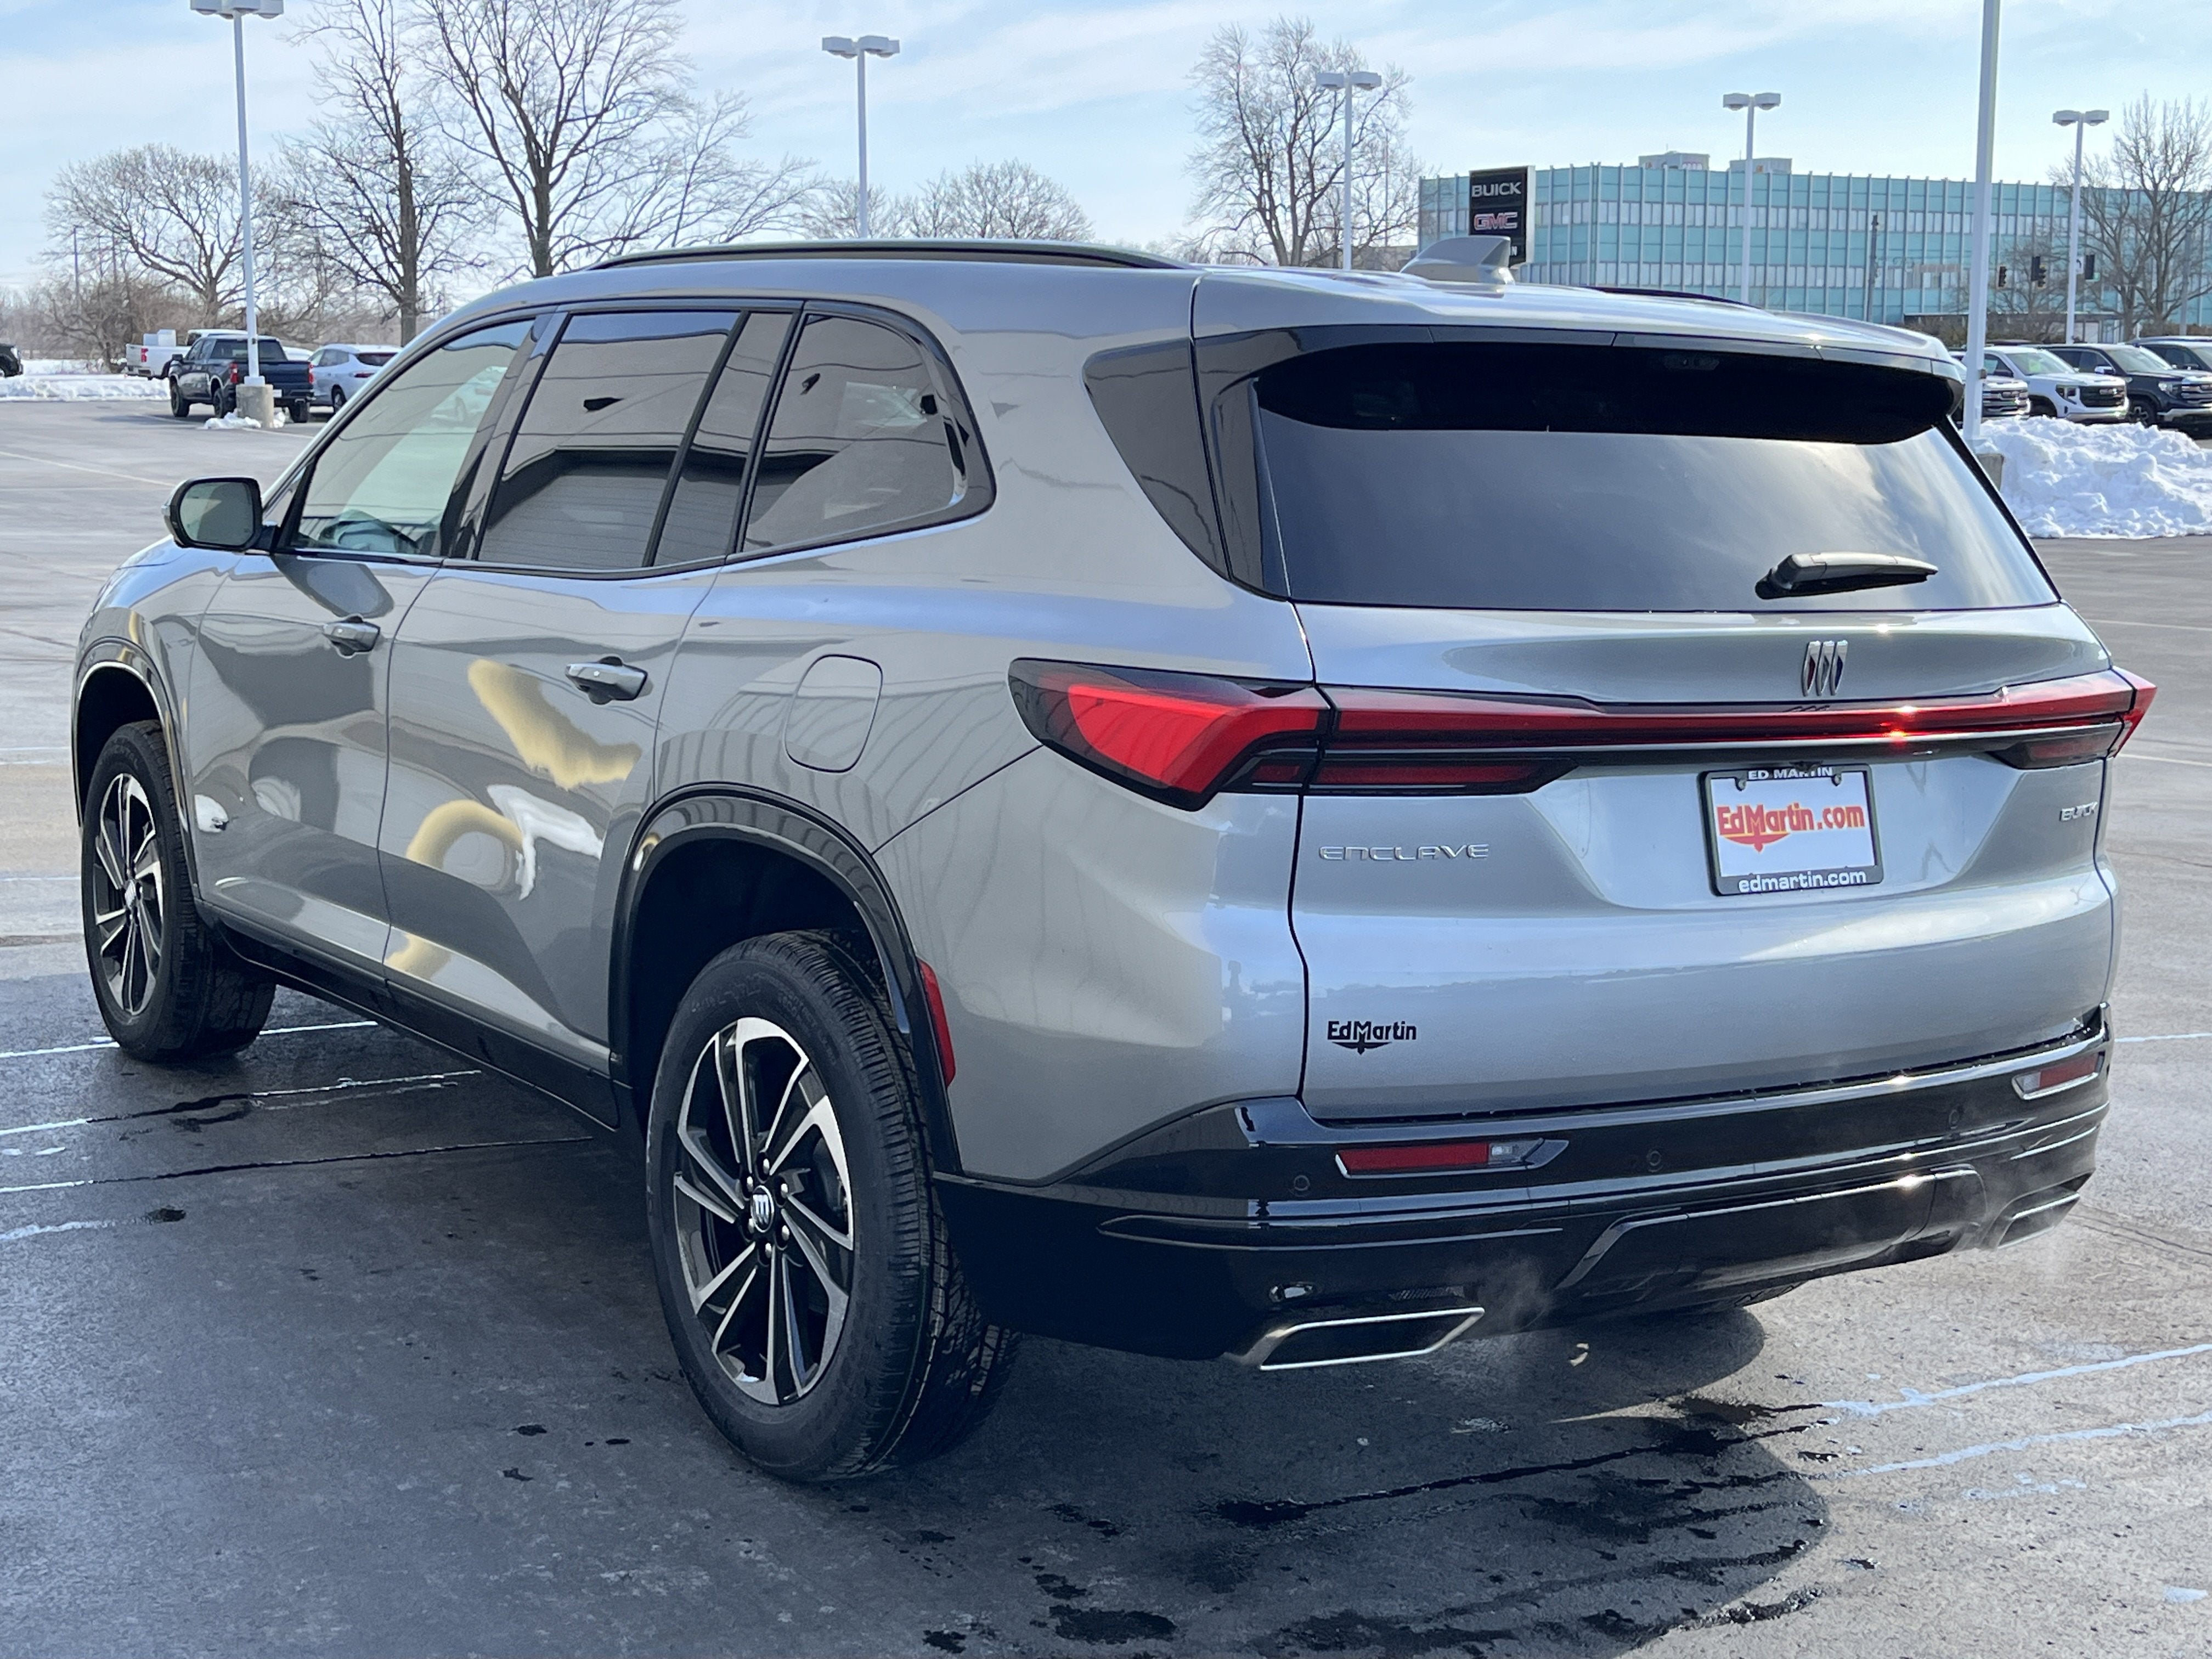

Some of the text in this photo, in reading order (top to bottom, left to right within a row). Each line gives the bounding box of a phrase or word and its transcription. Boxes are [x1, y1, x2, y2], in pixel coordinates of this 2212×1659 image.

[1471, 182, 1522, 198] BUICK
[1474, 212, 1518, 230] GMC
[1748, 770, 1769, 780] ED
[1716, 802, 1865, 836] EdMartin.com
[1318, 843, 1489, 860] ENCLAVE
[1738, 871, 1867, 893] edmartin.com
[1327, 1020, 1417, 1040] EdMartin
